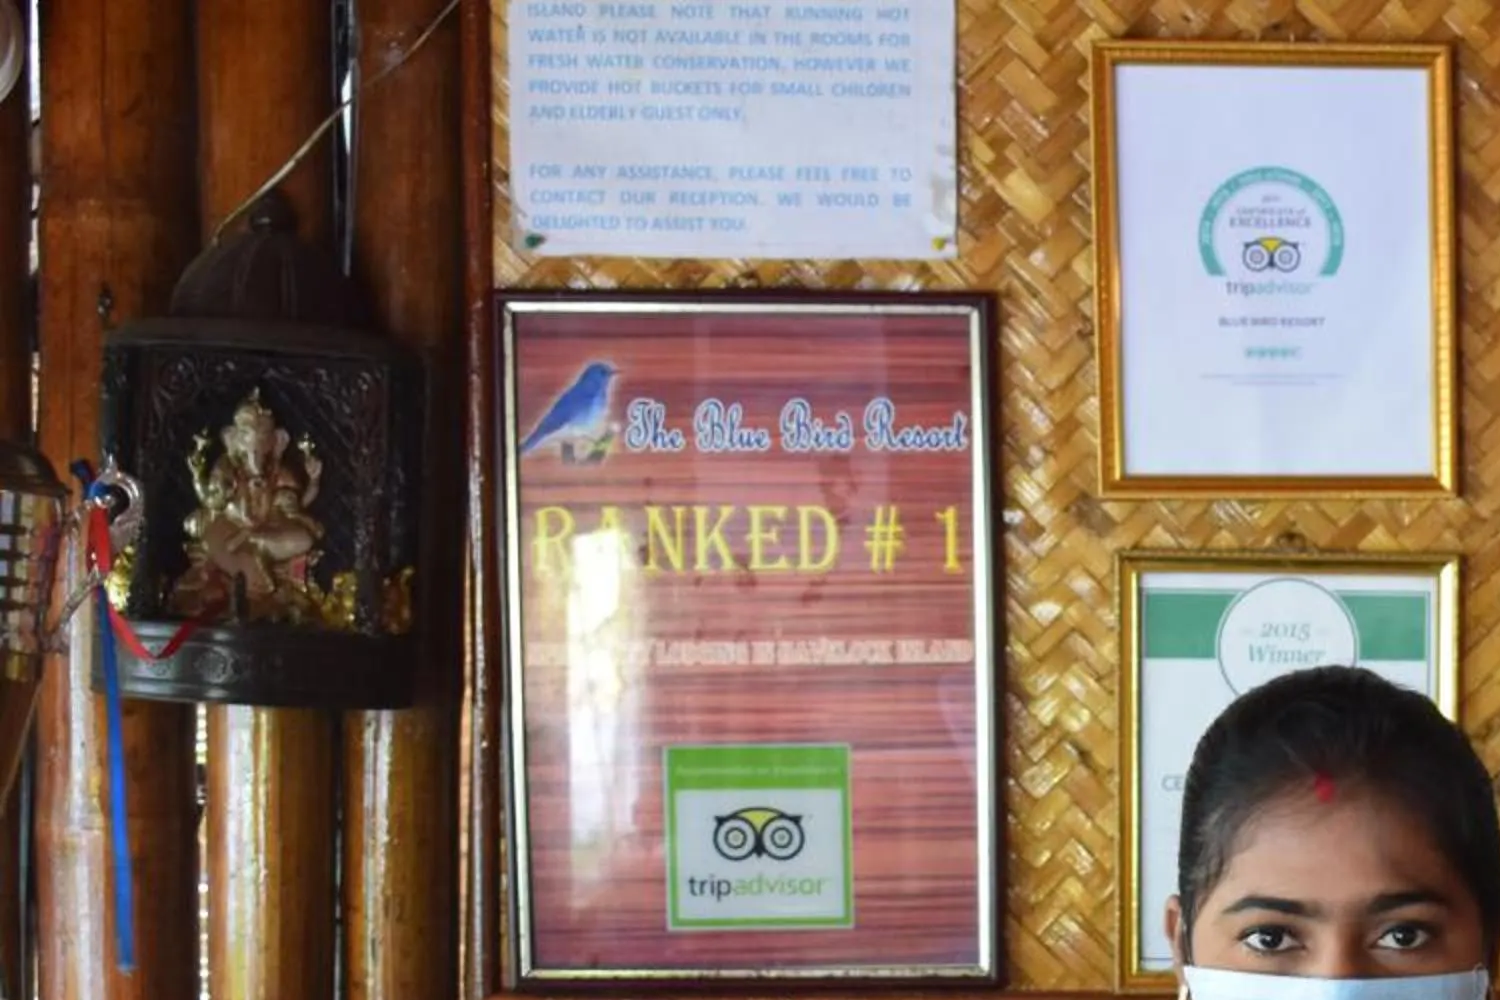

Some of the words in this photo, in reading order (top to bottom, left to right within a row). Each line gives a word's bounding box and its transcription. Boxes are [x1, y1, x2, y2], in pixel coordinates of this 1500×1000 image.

[600, 4, 657, 19] PLEASE
[671, 5, 714, 19] NOTE
[729, 6, 771, 20] THAT
[785, 6, 863, 21] RUNNING
[876, 7, 909, 21] HOT
[528, 29, 586, 43] WATER
[592, 30, 606, 44] IS
[613, 30, 648, 44] NOT
[655, 30, 740, 45] AVAILABLE
[748, 32, 766, 46] IN
[774, 31, 801, 46] THE
[810, 32, 872, 46] ROOMS
[879, 33, 910, 47] FOR
[528, 54, 577, 68] FRESH
[587, 54, 643, 69] WATER
[794, 58, 876, 72] HOWEVER
[884, 59, 911, 72] WE
[529, 80, 598, 94] PROVIDE
[608, 81, 641, 94] HOT
[651, 81, 721, 95] BUCKETS
[729, 82, 762, 95] FOR
[771, 83, 824, 97] SMALL
[832, 83, 911, 98] CHILDREN
[529, 105, 565, 119] AND
[570, 106, 635, 120] ELDERLY
[641, 106, 692, 120] GUEST
[529, 164, 561, 178] FOR
[573, 165, 606, 178] ANY
[729, 166, 784, 180] PLEASE
[796, 166, 830, 181] FEEL
[842, 167, 878, 181] FREE
[892, 168, 911, 182] TO
[530, 190, 606, 203] CONTACT
[620, 191, 656, 204] OUR
[777, 193, 801, 207] WE
[817, 193, 879, 207] WOULD
[893, 194, 911, 207] BE
[533, 215, 620, 230] DELIGHTED
[627, 217, 648, 230] TO
[651, 216, 707, 231] ASSIST
[1226, 280, 1313, 297] tripadvisor
[626, 397, 683, 452] The
[695, 397, 771, 452] Blue
[780, 396, 853, 452] Bird
[864, 396, 967, 452] Resort
[864, 505, 905, 574] #
[935, 505, 965, 573] 1
[1259, 622, 1312, 641] 2015
[1247, 643, 1327, 665] Winner
[688, 874, 826, 902] tripadvisor
